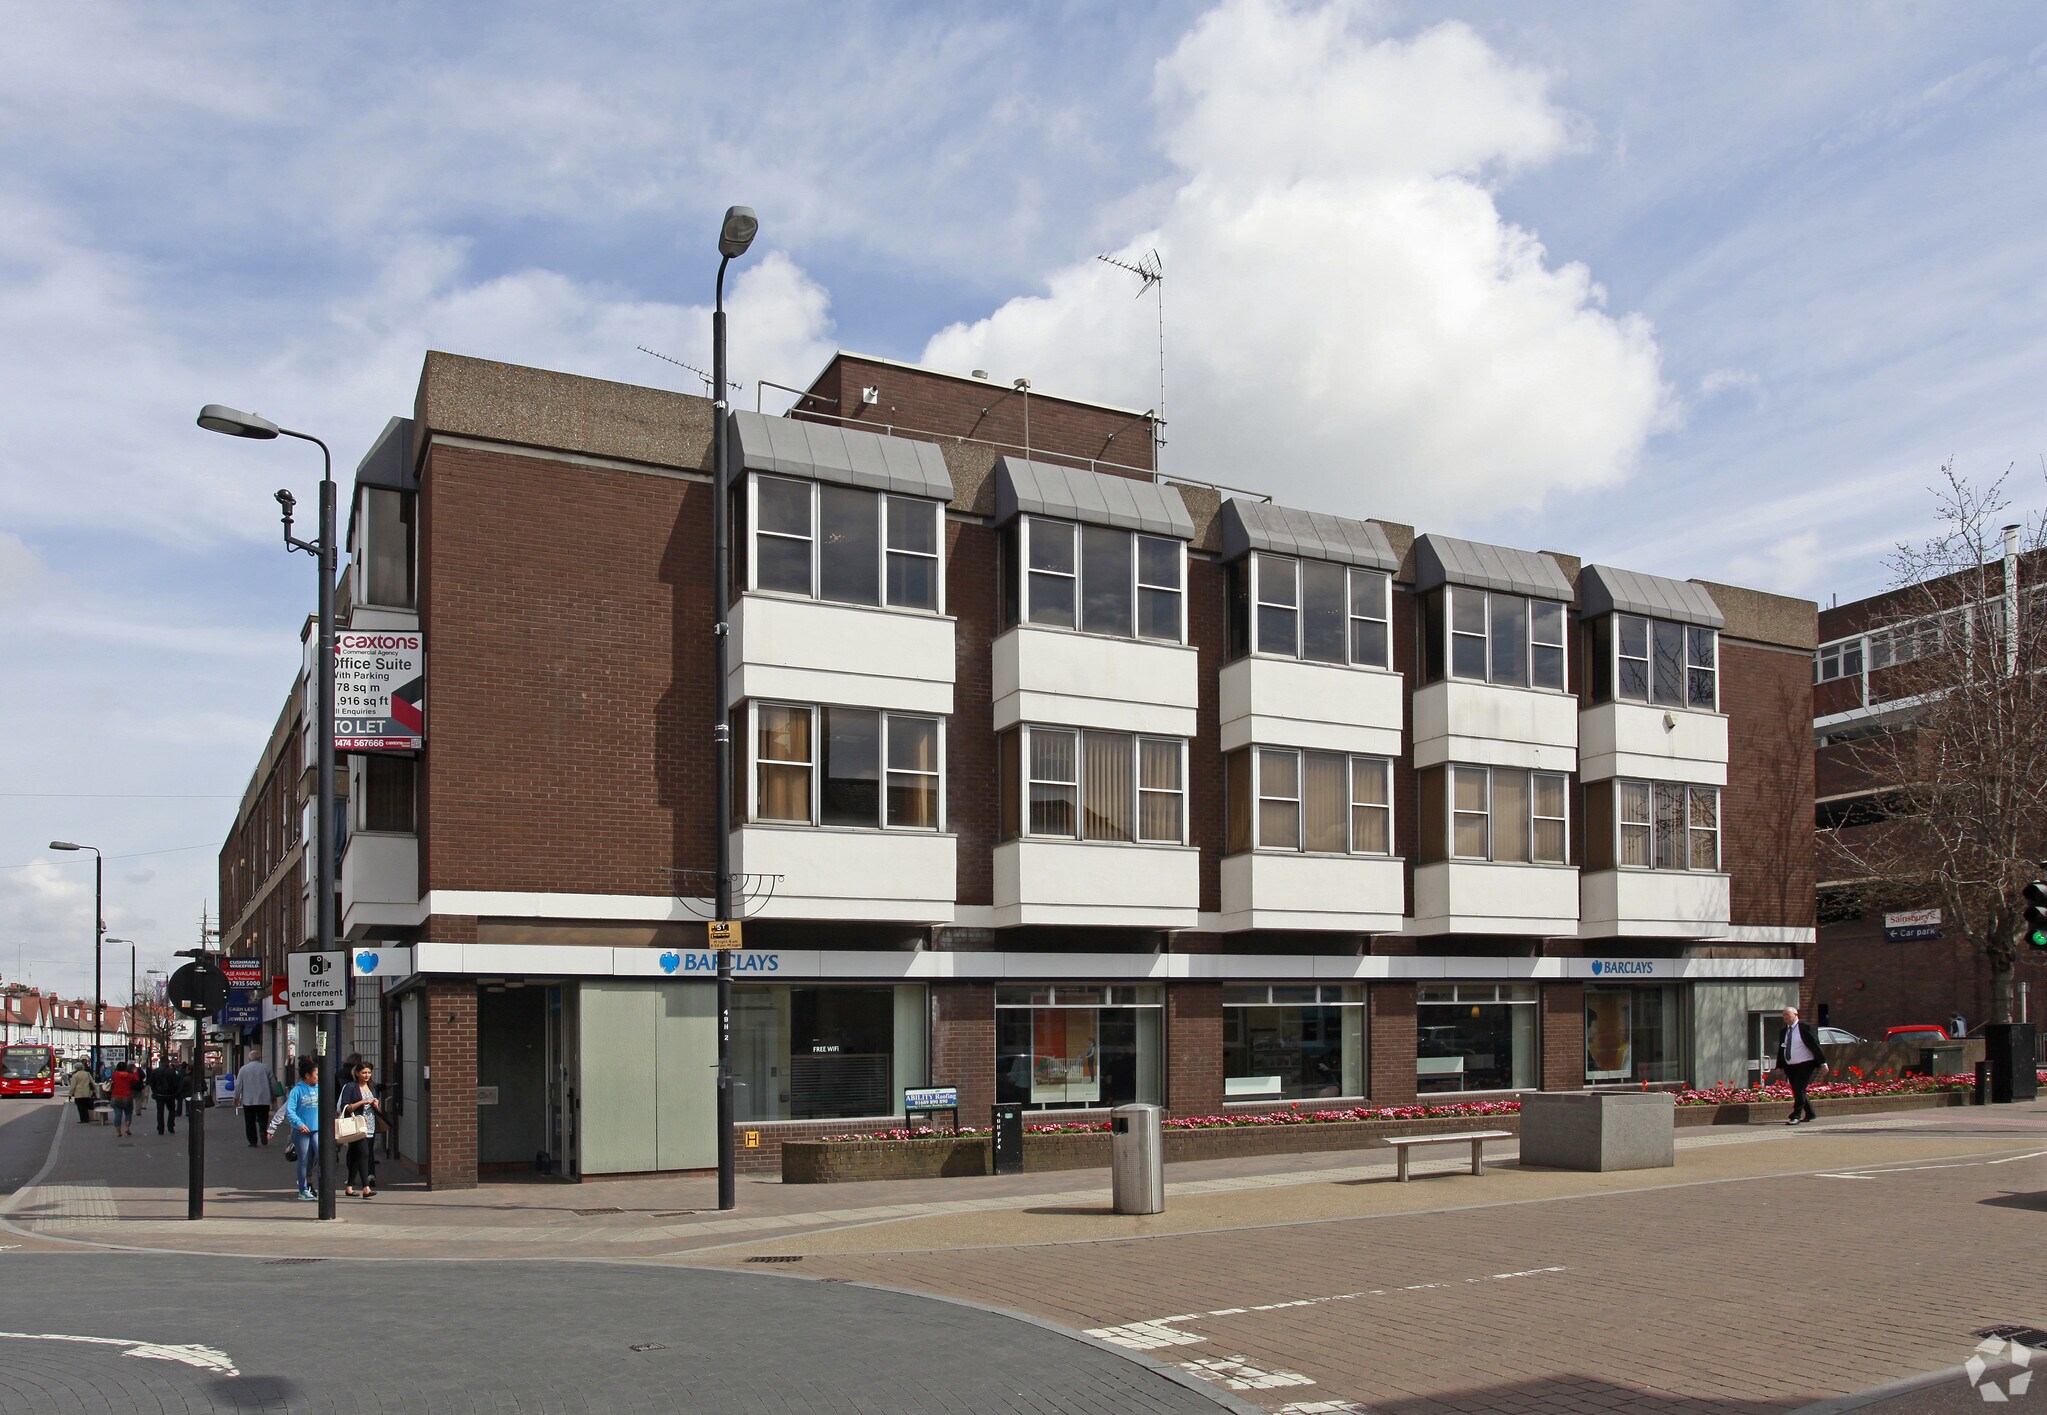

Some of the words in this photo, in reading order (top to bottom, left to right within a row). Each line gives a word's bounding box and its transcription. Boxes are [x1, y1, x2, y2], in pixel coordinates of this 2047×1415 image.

[342, 634, 419, 650] caxtons
[375, 657, 412, 670] Suite
[354, 671, 390, 682] Parking
[336, 682, 350, 692] 78
[353, 684, 367, 694] sq
[336, 696, 360, 706] ,916
[363, 698, 377, 708] sq
[379, 696, 389, 706] ft
[341, 708, 377, 716] Enquiries
[356, 720, 386, 734] LET
[334, 739, 352, 747] 1474
[353, 739, 384, 747] 567666
[1900, 929, 1914, 937] Car
[1916, 928, 1935, 937] park
[684, 953, 779, 971] BALAYS
[1604, 961, 1653, 974] BARCLAYS
[303, 979, 330, 988] Traffic
[291, 988, 343, 998] enforcement
[747, 1133, 757, 1146] H
